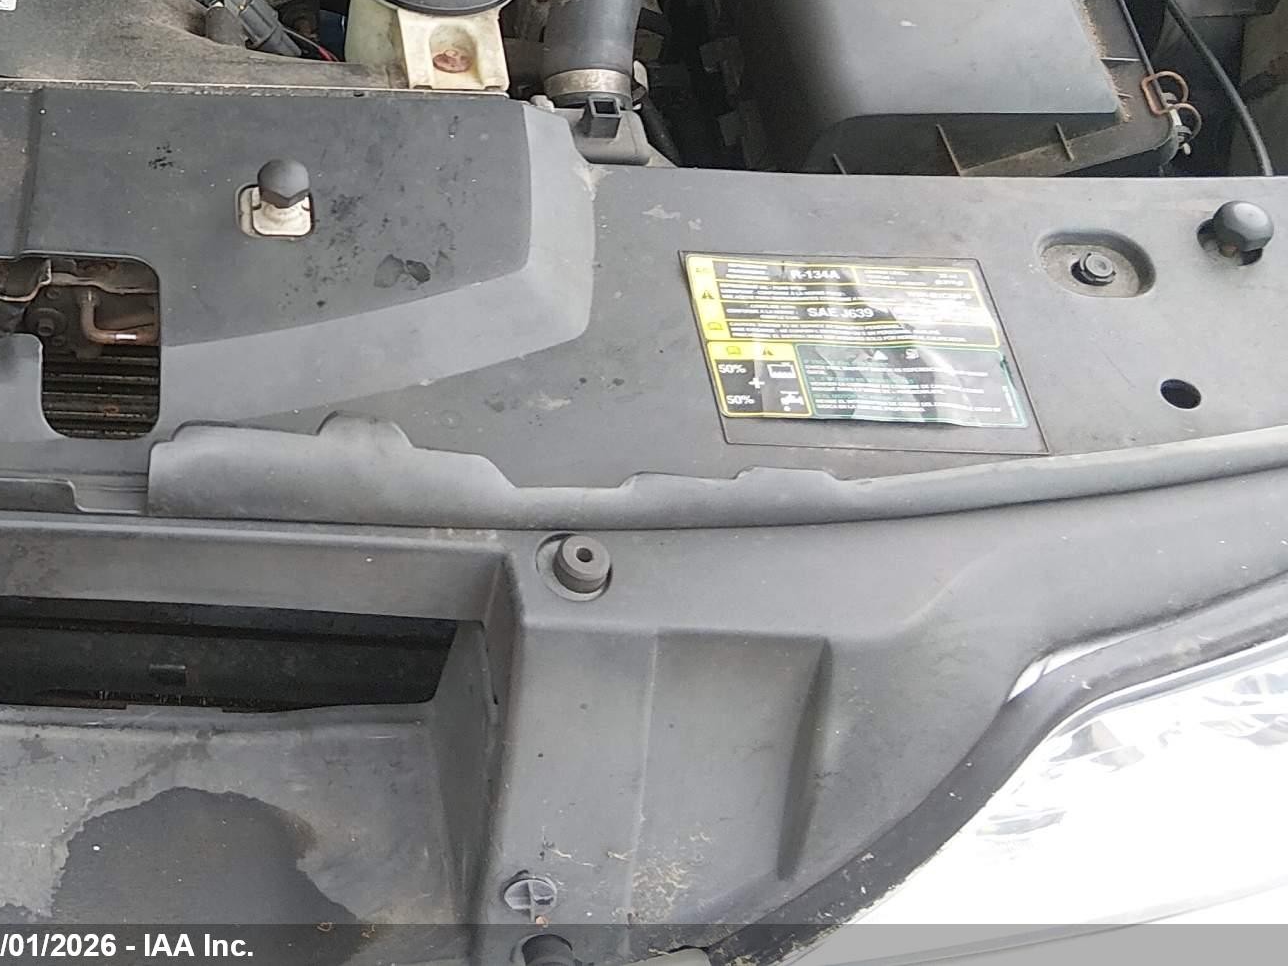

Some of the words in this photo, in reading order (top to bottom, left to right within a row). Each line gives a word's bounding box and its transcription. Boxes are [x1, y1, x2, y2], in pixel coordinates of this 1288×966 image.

[790, 269, 840, 280] R-134A
[806, 307, 838, 318] SAE
[840, 307, 874, 319] J639
[718, 363, 747, 374] 50%
[726, 394, 755, 405] 50%
